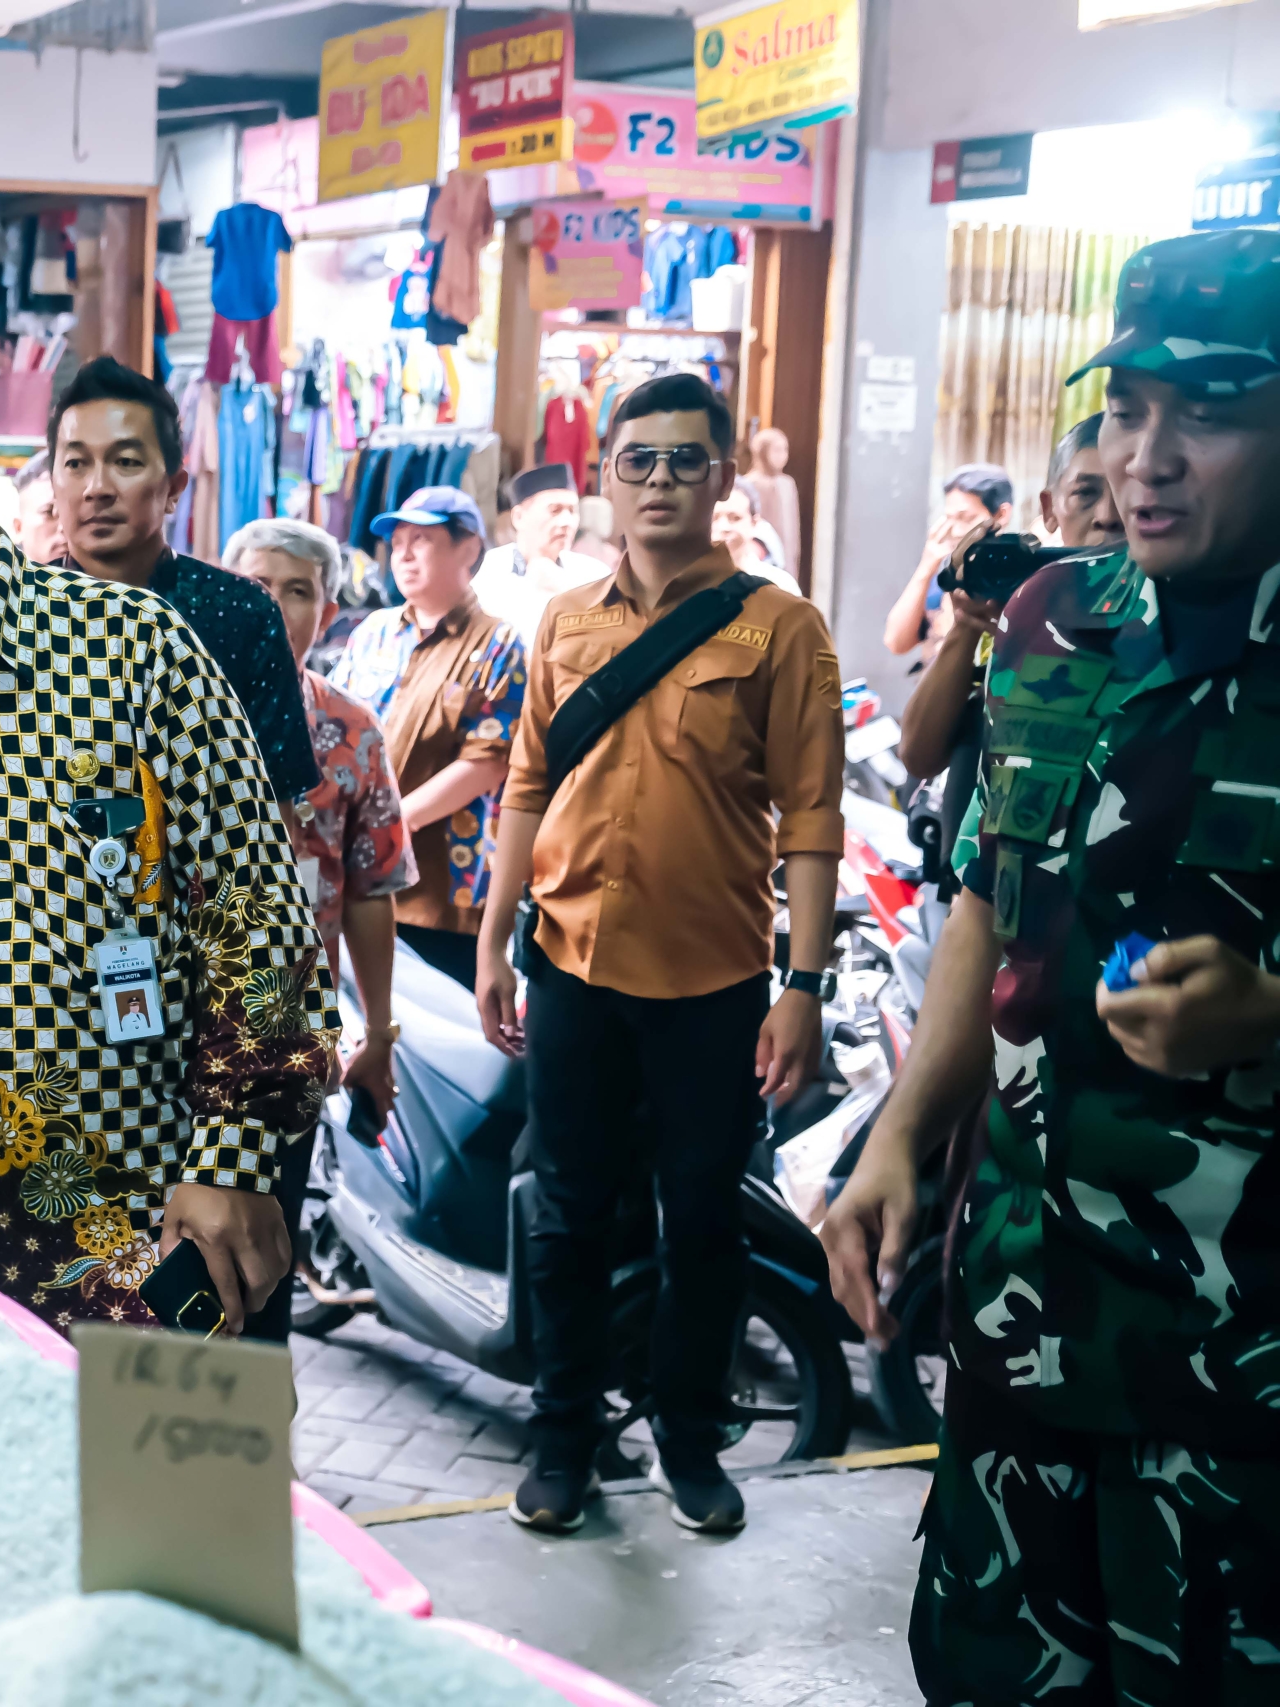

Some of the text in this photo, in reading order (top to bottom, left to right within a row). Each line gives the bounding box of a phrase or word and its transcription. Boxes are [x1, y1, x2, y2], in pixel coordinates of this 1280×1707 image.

[731, 9, 836, 75] Salma
[628, 112, 675, 155] F2
[107, 960, 145, 970] MAGELANG
[114, 973, 141, 981] WALIKOTA
